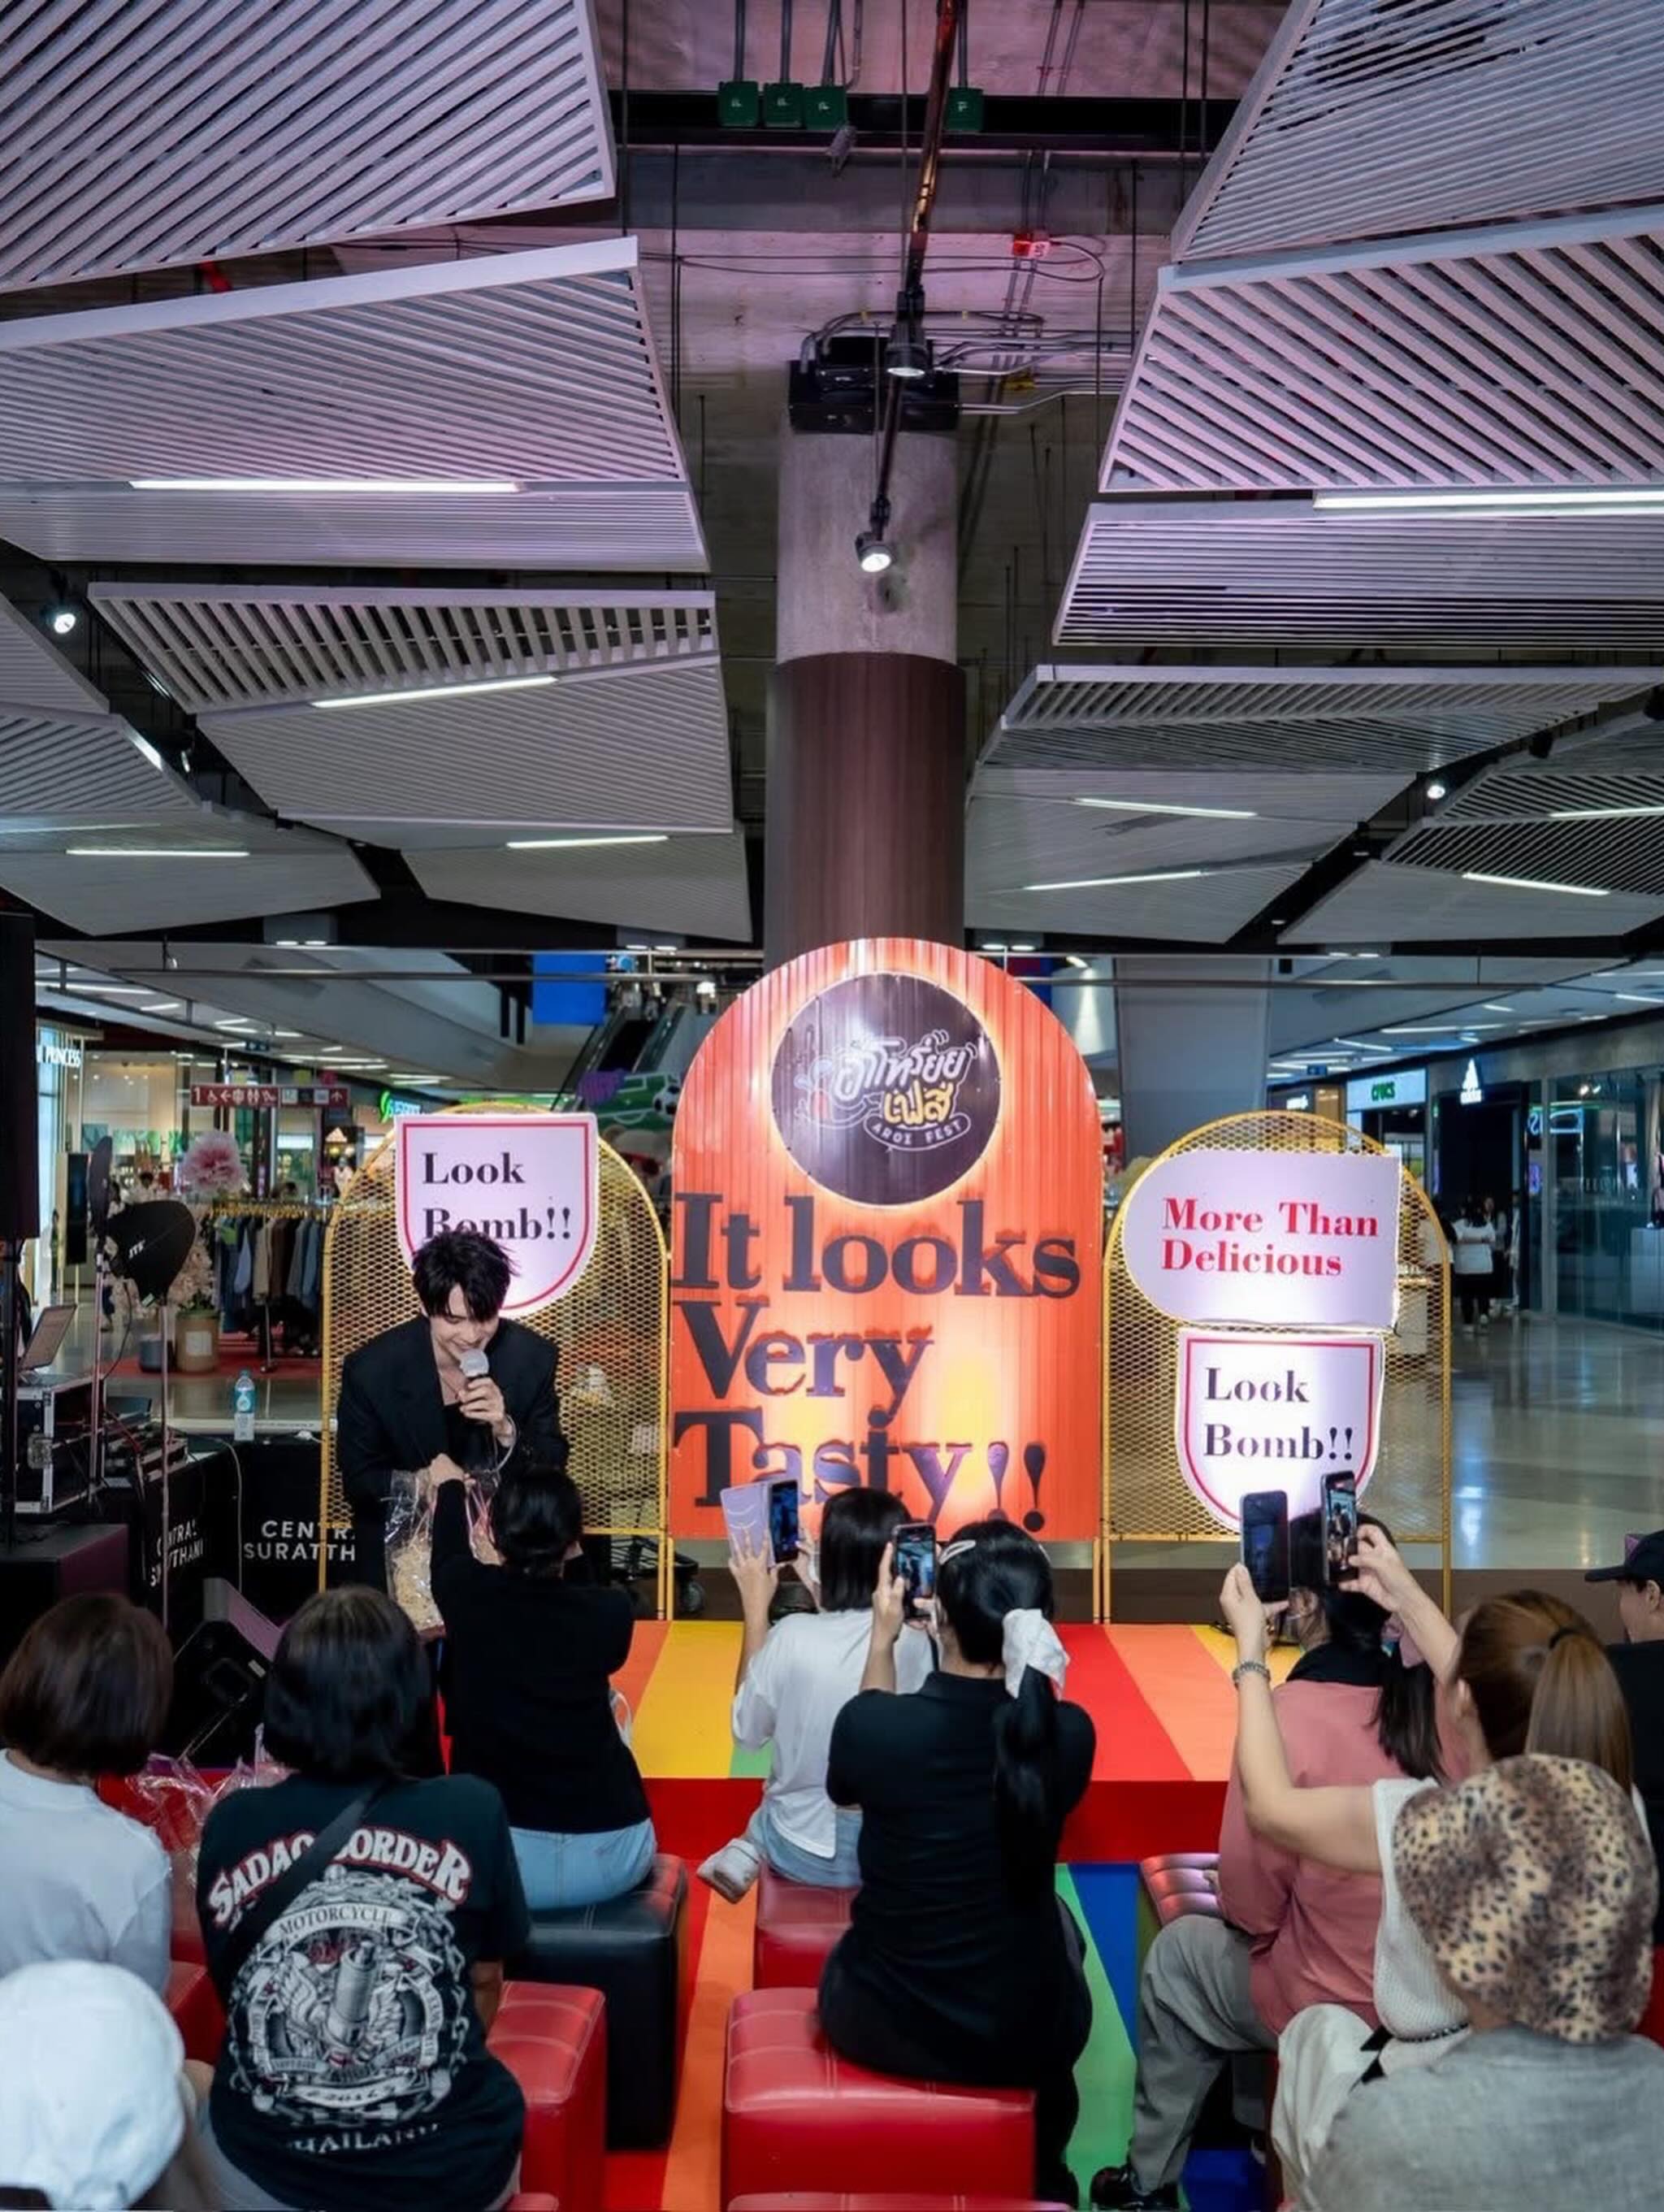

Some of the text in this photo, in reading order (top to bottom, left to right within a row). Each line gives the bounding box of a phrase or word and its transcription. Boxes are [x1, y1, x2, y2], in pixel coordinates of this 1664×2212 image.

[193, 1086, 202, 1104] 1
[872, 1120, 962, 1145] AROI FEST
[422, 1152, 526, 1185] Look
[1163, 1197, 1379, 1238] More Than
[671, 1192, 1081, 1299] It looks
[1161, 1238, 1342, 1277] Delicious
[672, 1299, 934, 1427] Very
[1205, 1367, 1311, 1403] Look
[1203, 1423, 1354, 1462] Bomb!!
[334, 1827, 470, 1903] ORDER
